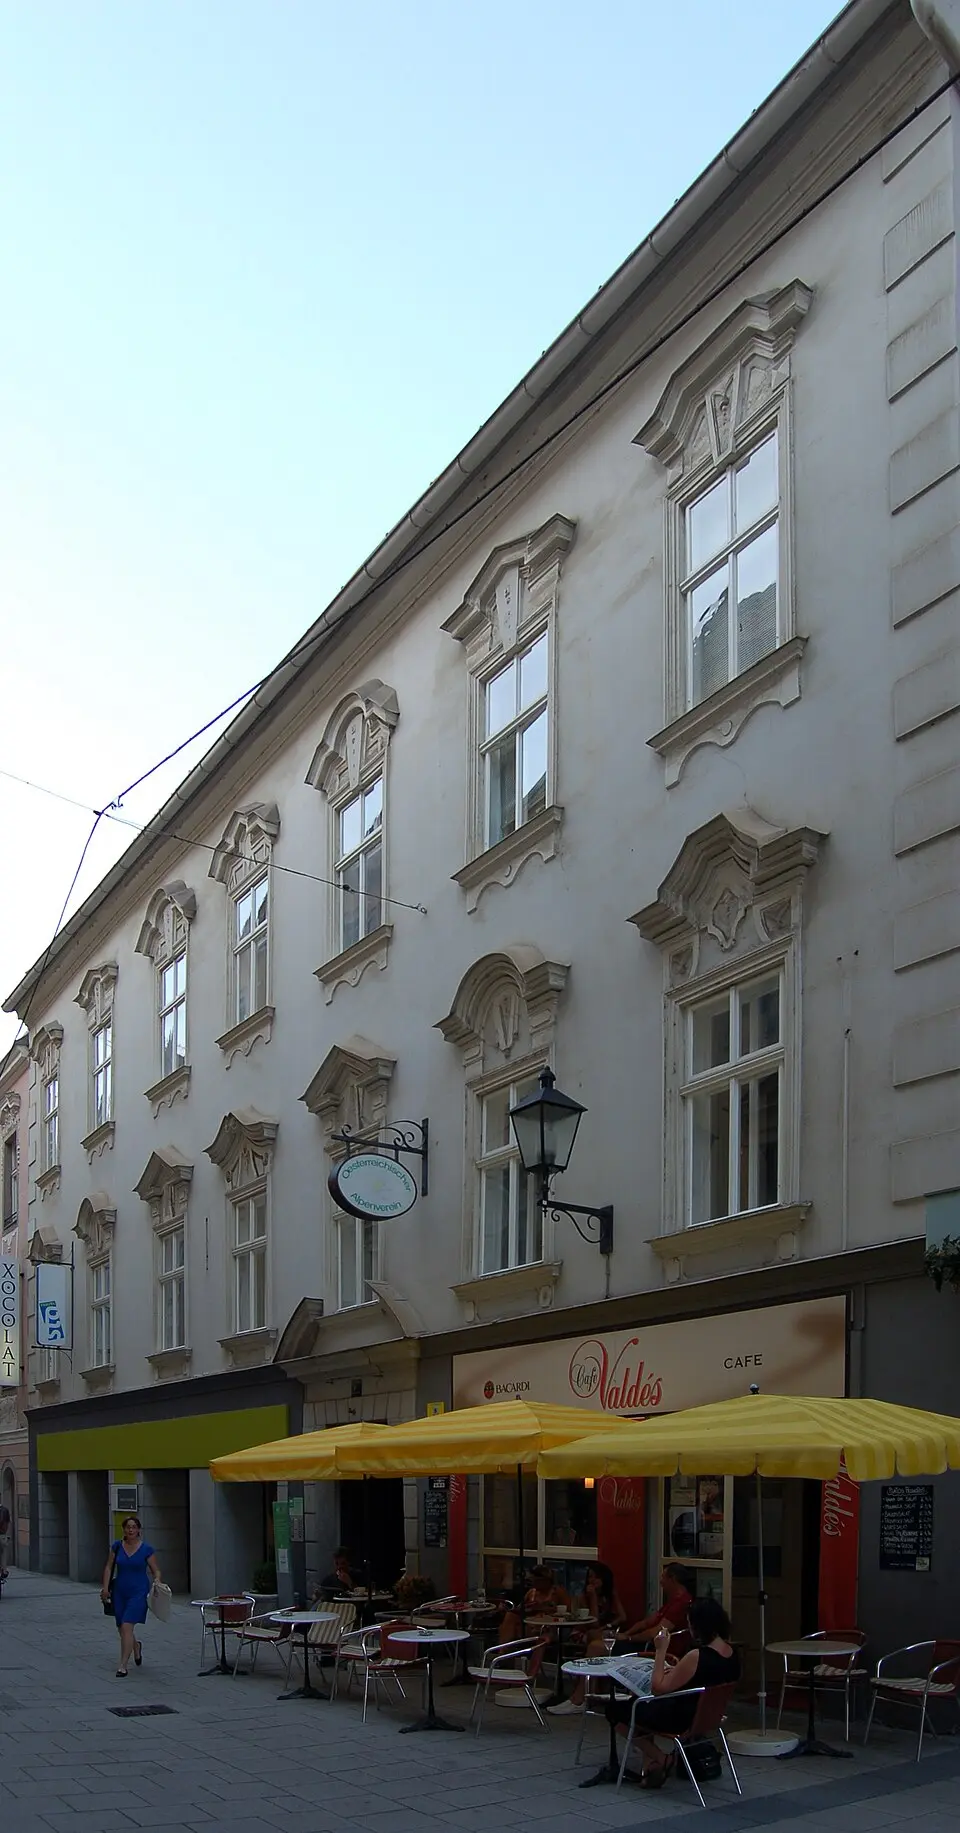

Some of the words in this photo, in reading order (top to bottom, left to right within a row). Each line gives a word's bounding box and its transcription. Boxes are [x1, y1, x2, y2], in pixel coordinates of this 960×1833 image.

[341, 1158, 411, 1192] Oesterreichischer
[350, 1192, 402, 1212] Alpenverein
[1, 1263, 16, 1377] XOCOLAT
[569, 1338, 662, 1410] Valdés
[723, 1353, 763, 1369] CAFE
[496, 1381, 530, 1394] BACARDI
